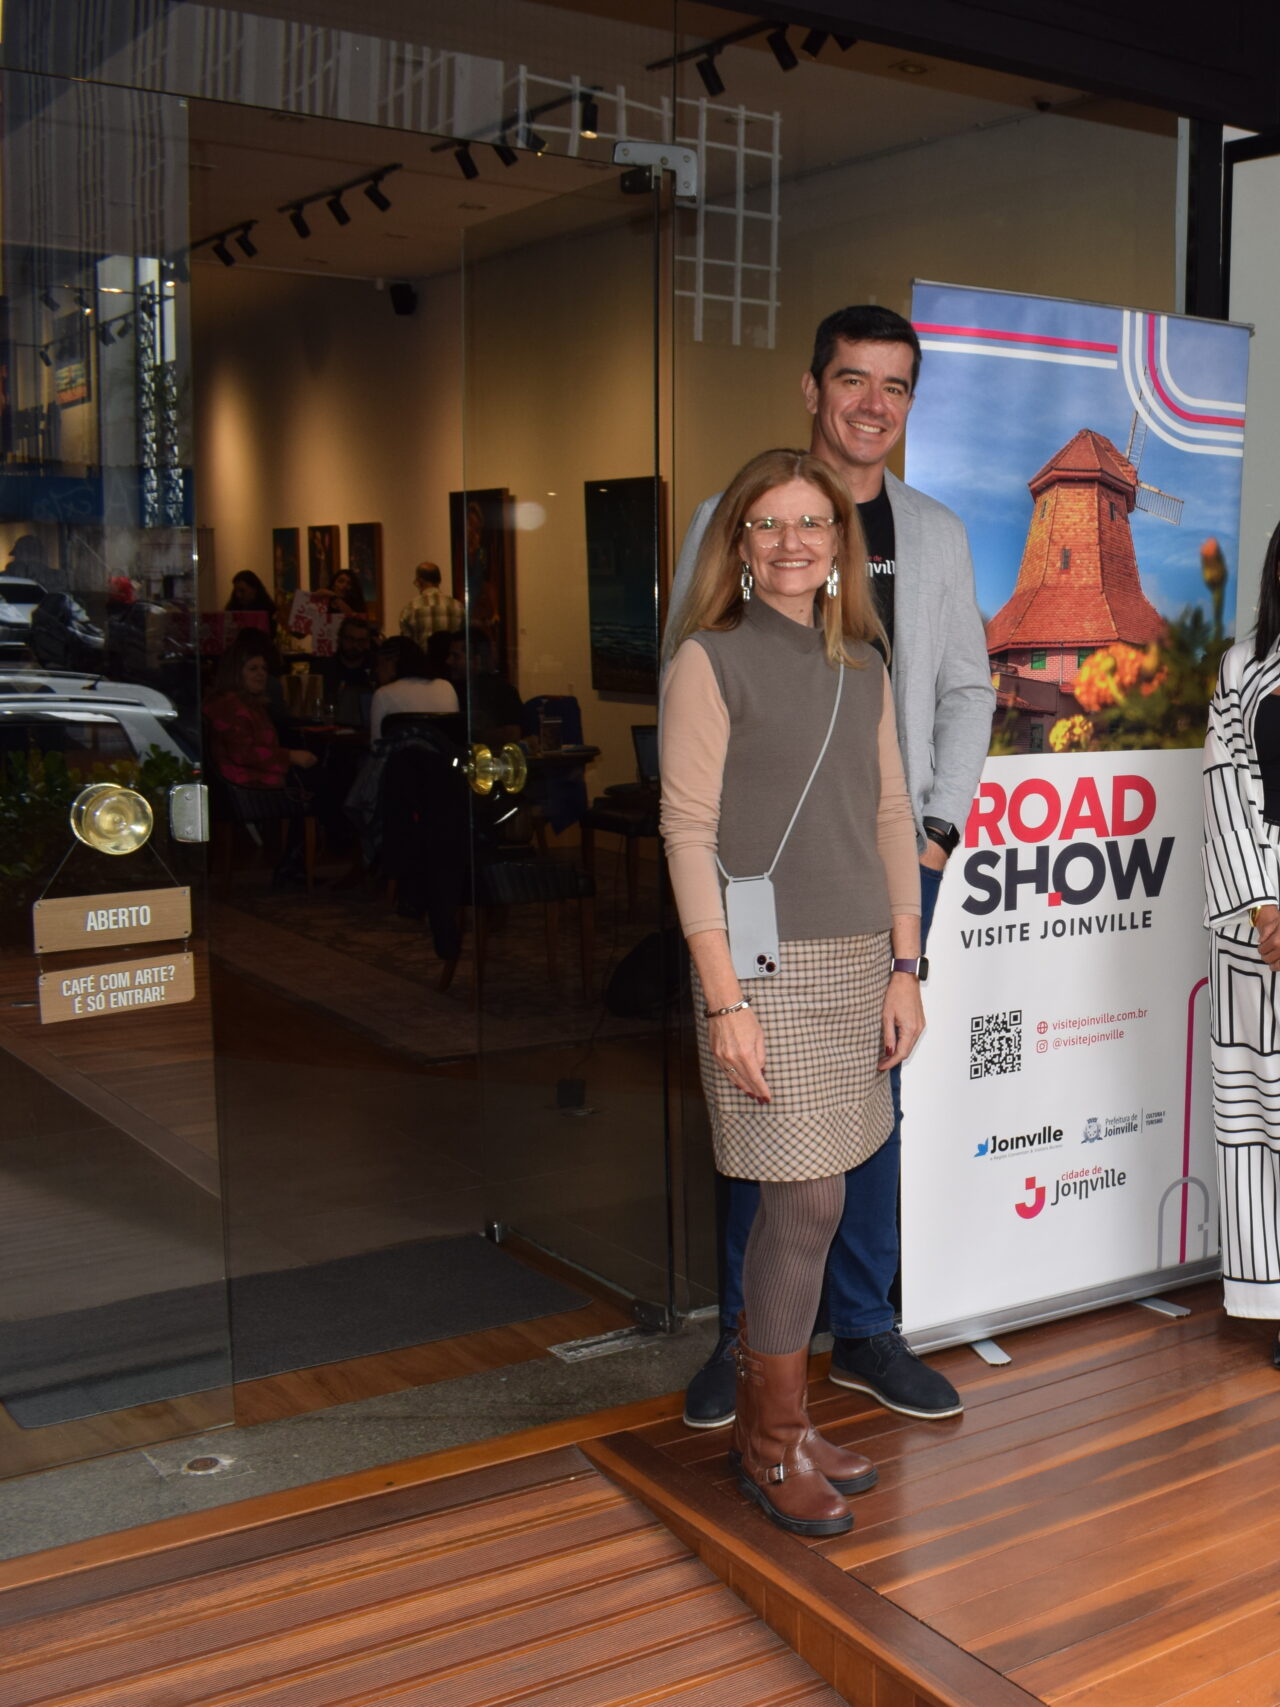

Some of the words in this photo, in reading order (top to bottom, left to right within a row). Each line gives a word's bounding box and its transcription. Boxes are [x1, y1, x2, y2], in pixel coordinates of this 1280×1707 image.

[964, 774, 1157, 848] ROAD
[961, 836, 1176, 916] SHOW
[85, 905, 151, 932] ABERTO
[960, 922, 1030, 949] VISITE
[1040, 910, 1153, 940] JOINVILLE
[62, 974, 96, 997] CAFÉ
[99, 971, 130, 991] COM
[134, 965, 176, 986] ARTE?
[73, 994, 83, 1014] É
[86, 991, 105, 1012] SÓ
[109, 985, 165, 1009] ENTRAR!
[1052, 1008, 1148, 1030] visitejoinville.com.br
[1052, 1029, 1125, 1050] @visitejoinville
[1104, 1122, 1138, 1137] Joinville
[1105, 1115, 1130, 1125] Prefeitura
[1131, 1113, 1138, 1121] de
[990, 1125, 1064, 1154] Joinville
[1050, 1168, 1127, 1206] Joinville
[1061, 1167, 1090, 1181] cidade
[1091, 1165, 1103, 1176] de
